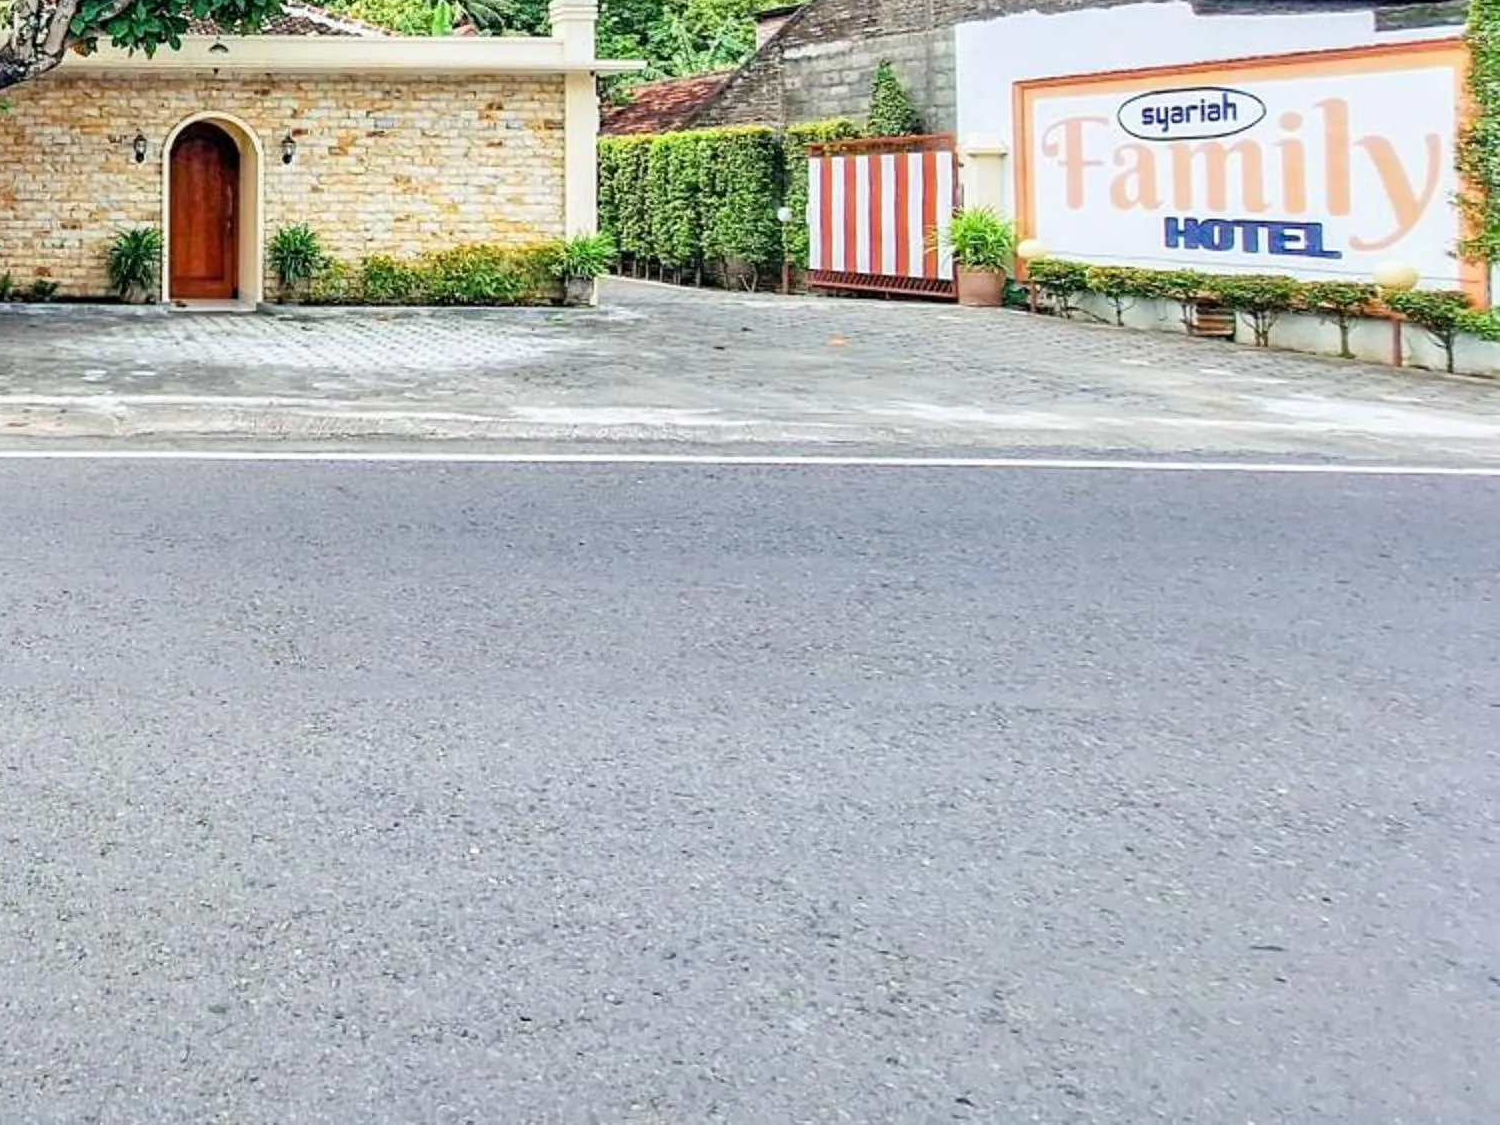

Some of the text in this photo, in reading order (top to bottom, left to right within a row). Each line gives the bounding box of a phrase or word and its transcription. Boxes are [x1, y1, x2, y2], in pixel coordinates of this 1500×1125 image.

[1141, 94, 1237, 131] syariah
[1043, 98, 1440, 250] Family
[1164, 216, 1342, 259] HOTEL
